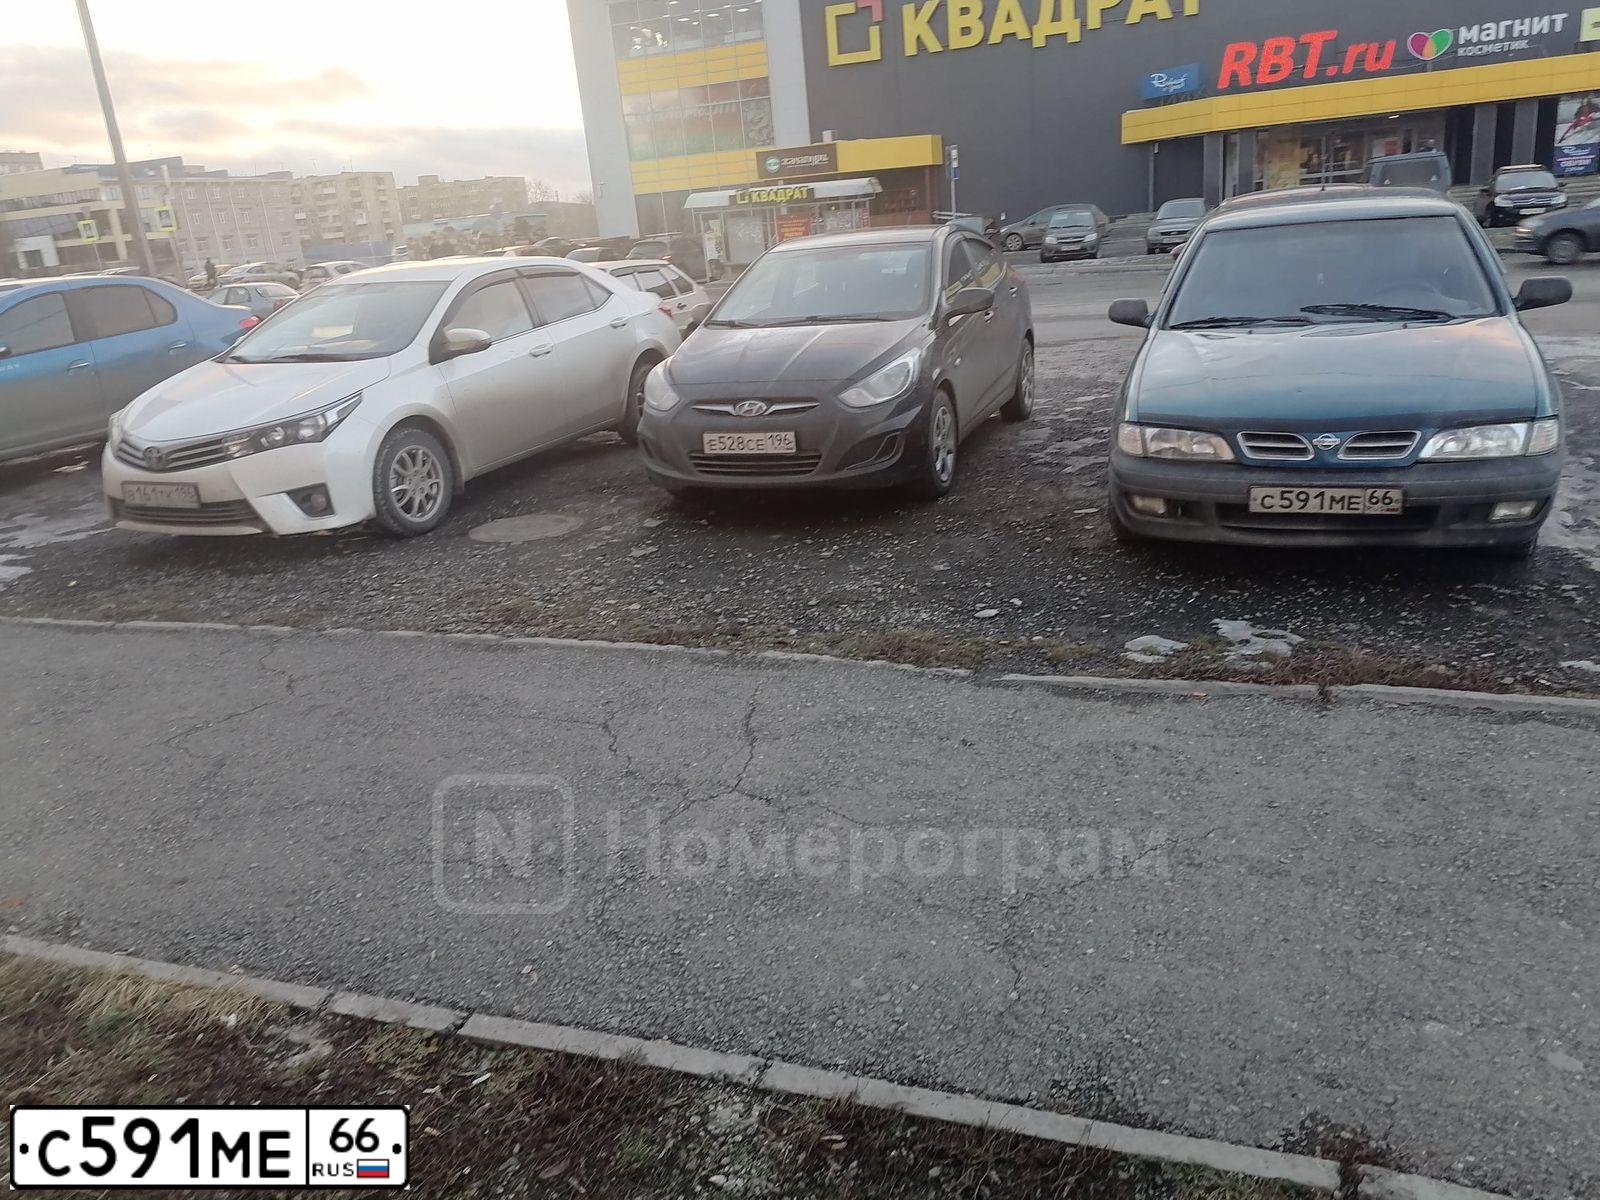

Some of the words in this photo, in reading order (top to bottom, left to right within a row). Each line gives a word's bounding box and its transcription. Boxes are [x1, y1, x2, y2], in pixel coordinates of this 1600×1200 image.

[1217, 30, 1397, 89] RBT.ru
[751, 186, 808, 204] КВАДРАТ
[1260, 490, 1362, 511] С591МЕ
[1368, 490, 1393, 506] 66
